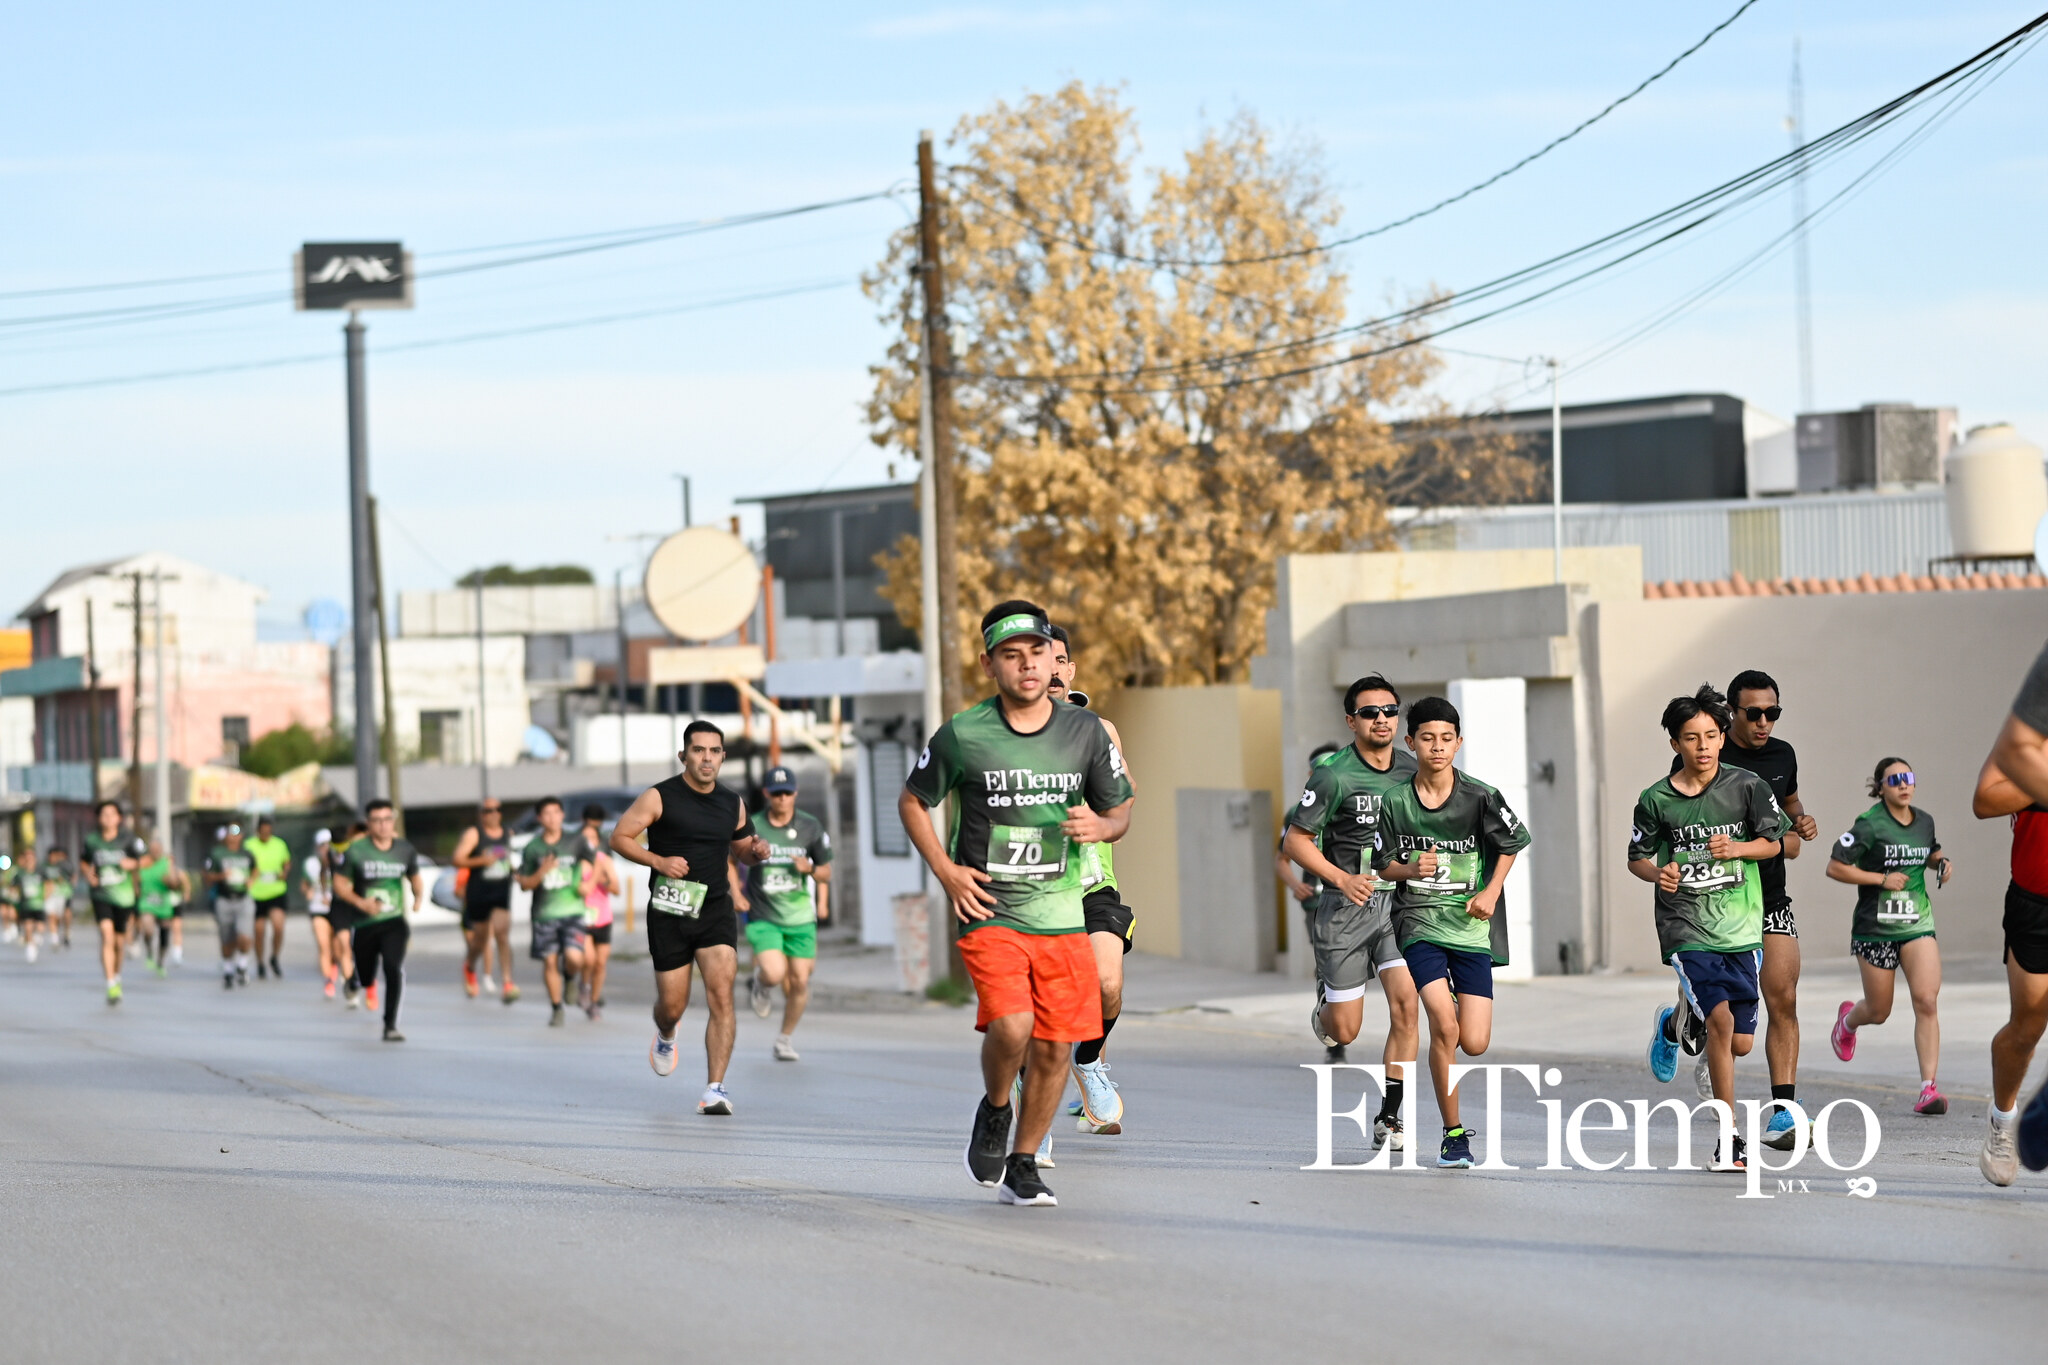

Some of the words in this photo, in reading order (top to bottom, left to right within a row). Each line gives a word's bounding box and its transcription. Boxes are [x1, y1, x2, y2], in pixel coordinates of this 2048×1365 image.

[983, 769, 1007, 791] El
[1009, 769, 1082, 792] Tiempo
[987, 793, 1012, 807] de
[1014, 791, 1068, 807] todos
[1355, 795, 1373, 812] El
[1356, 814, 1374, 824] de
[1397, 834, 1415, 849] El
[1671, 828, 1685, 843] El
[1008, 842, 1043, 865] 70
[1885, 844, 1898, 858] El
[1681, 861, 1726, 882] 236
[658, 885, 690, 905] 330
[1886, 900, 1914, 914] 118
